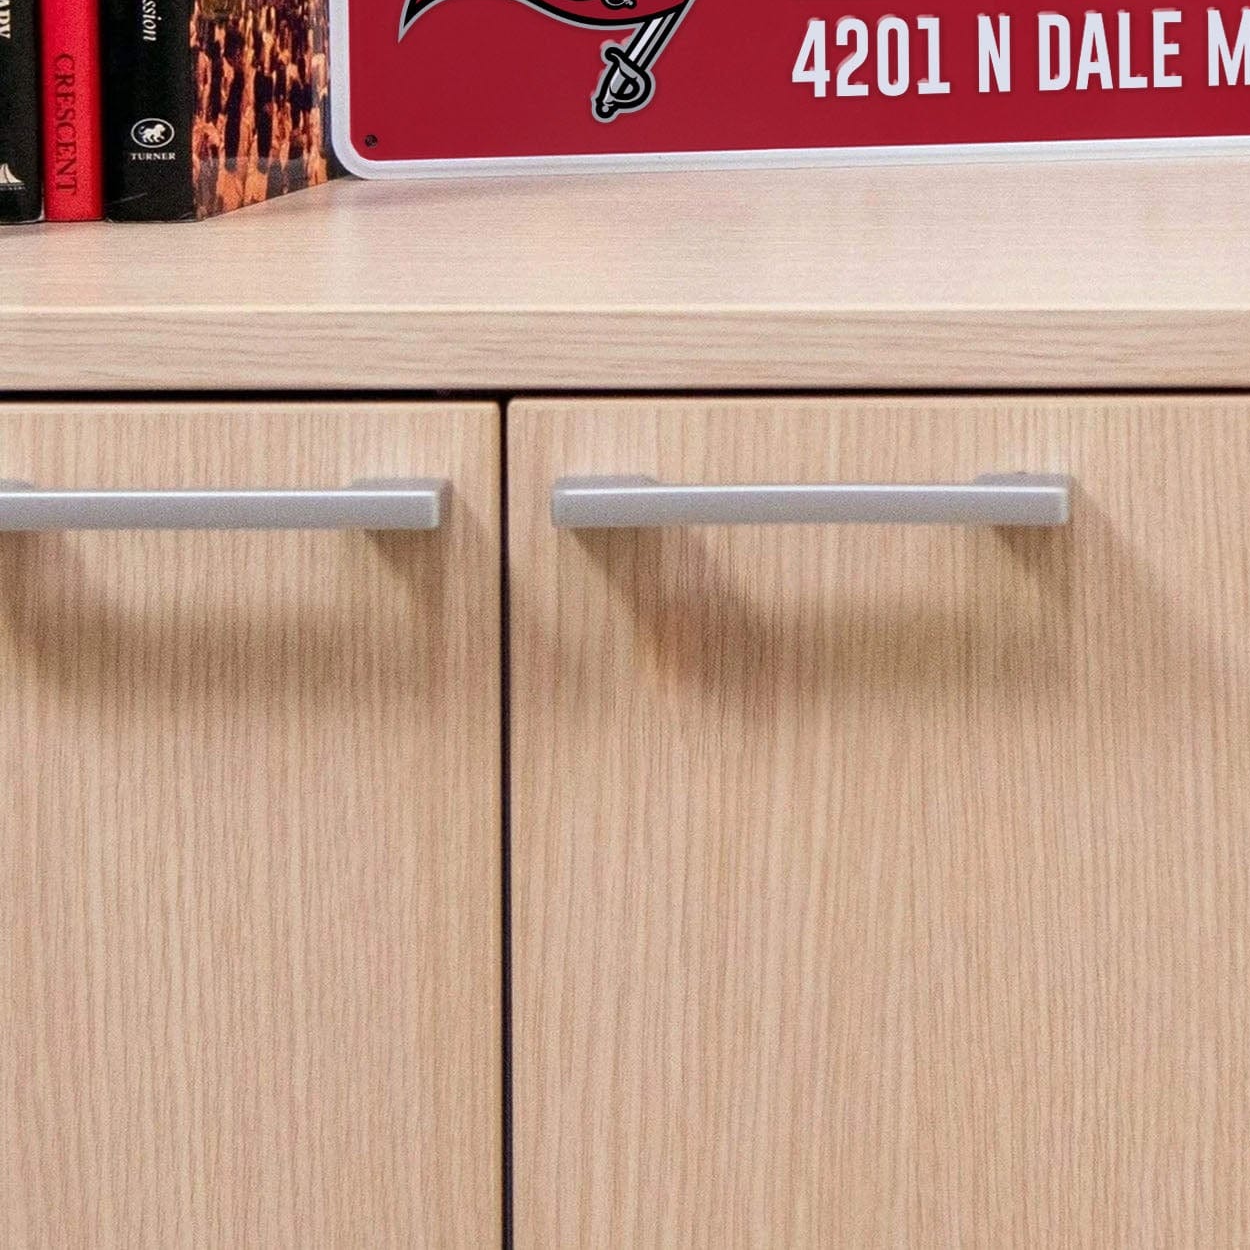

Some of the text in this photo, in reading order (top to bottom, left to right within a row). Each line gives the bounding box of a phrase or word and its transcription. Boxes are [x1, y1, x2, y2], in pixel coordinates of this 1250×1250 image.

[792, 15, 950, 97] 4201
[977, 13, 1011, 93] N
[1037, 9, 1182, 91] DALE
[55, 53, 77, 196] CRESCENT
[131, 152, 176, 161] TURNER
